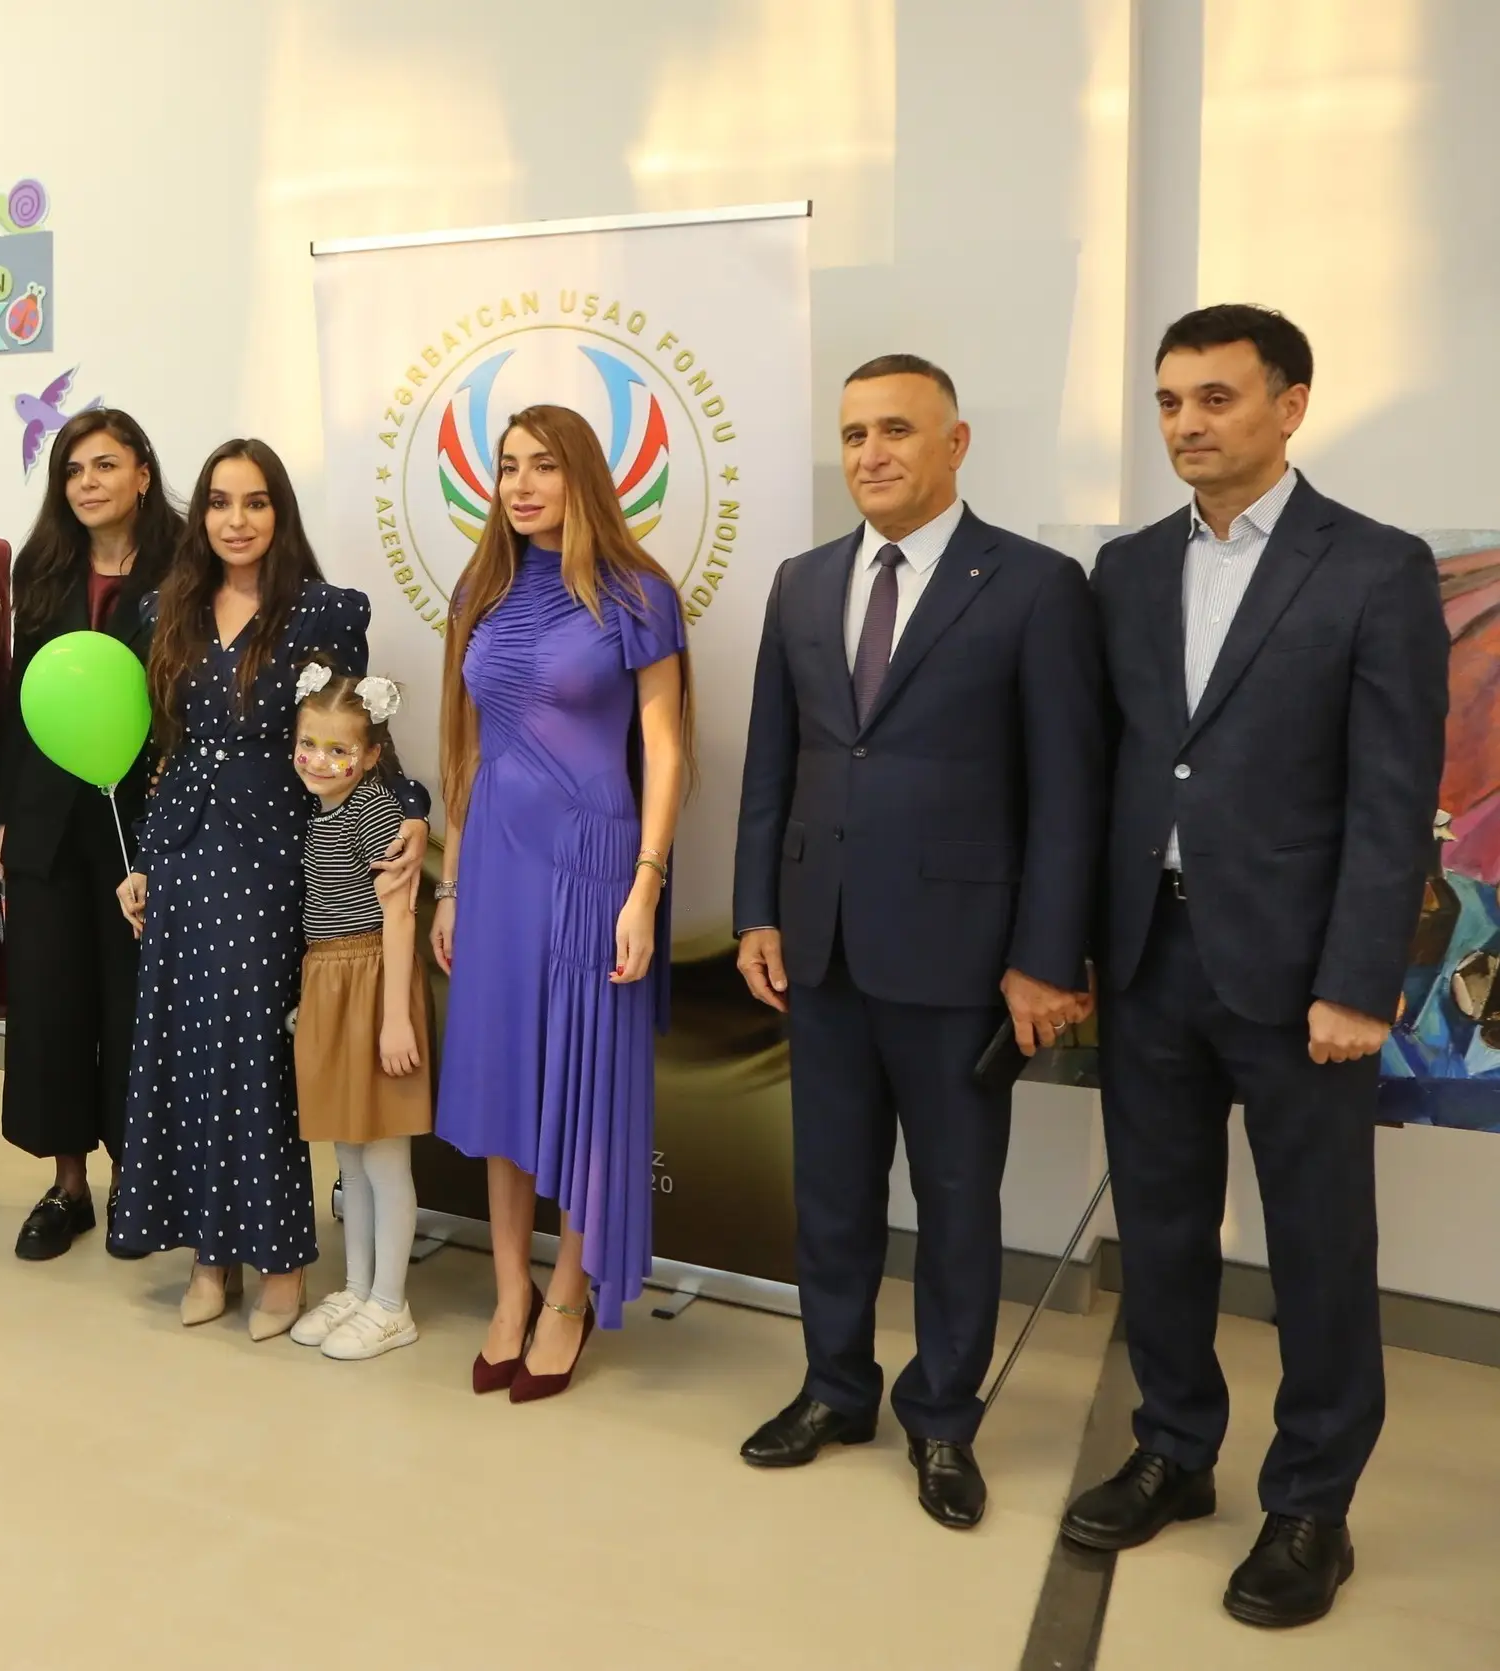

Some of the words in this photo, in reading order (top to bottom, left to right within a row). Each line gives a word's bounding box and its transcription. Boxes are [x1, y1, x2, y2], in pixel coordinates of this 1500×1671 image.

[559, 289, 647, 336] UŞAQ
[656, 331, 736, 443] FONDU
[374, 495, 448, 639] AZERBAIJA
[684, 499, 740, 626] NDATION
